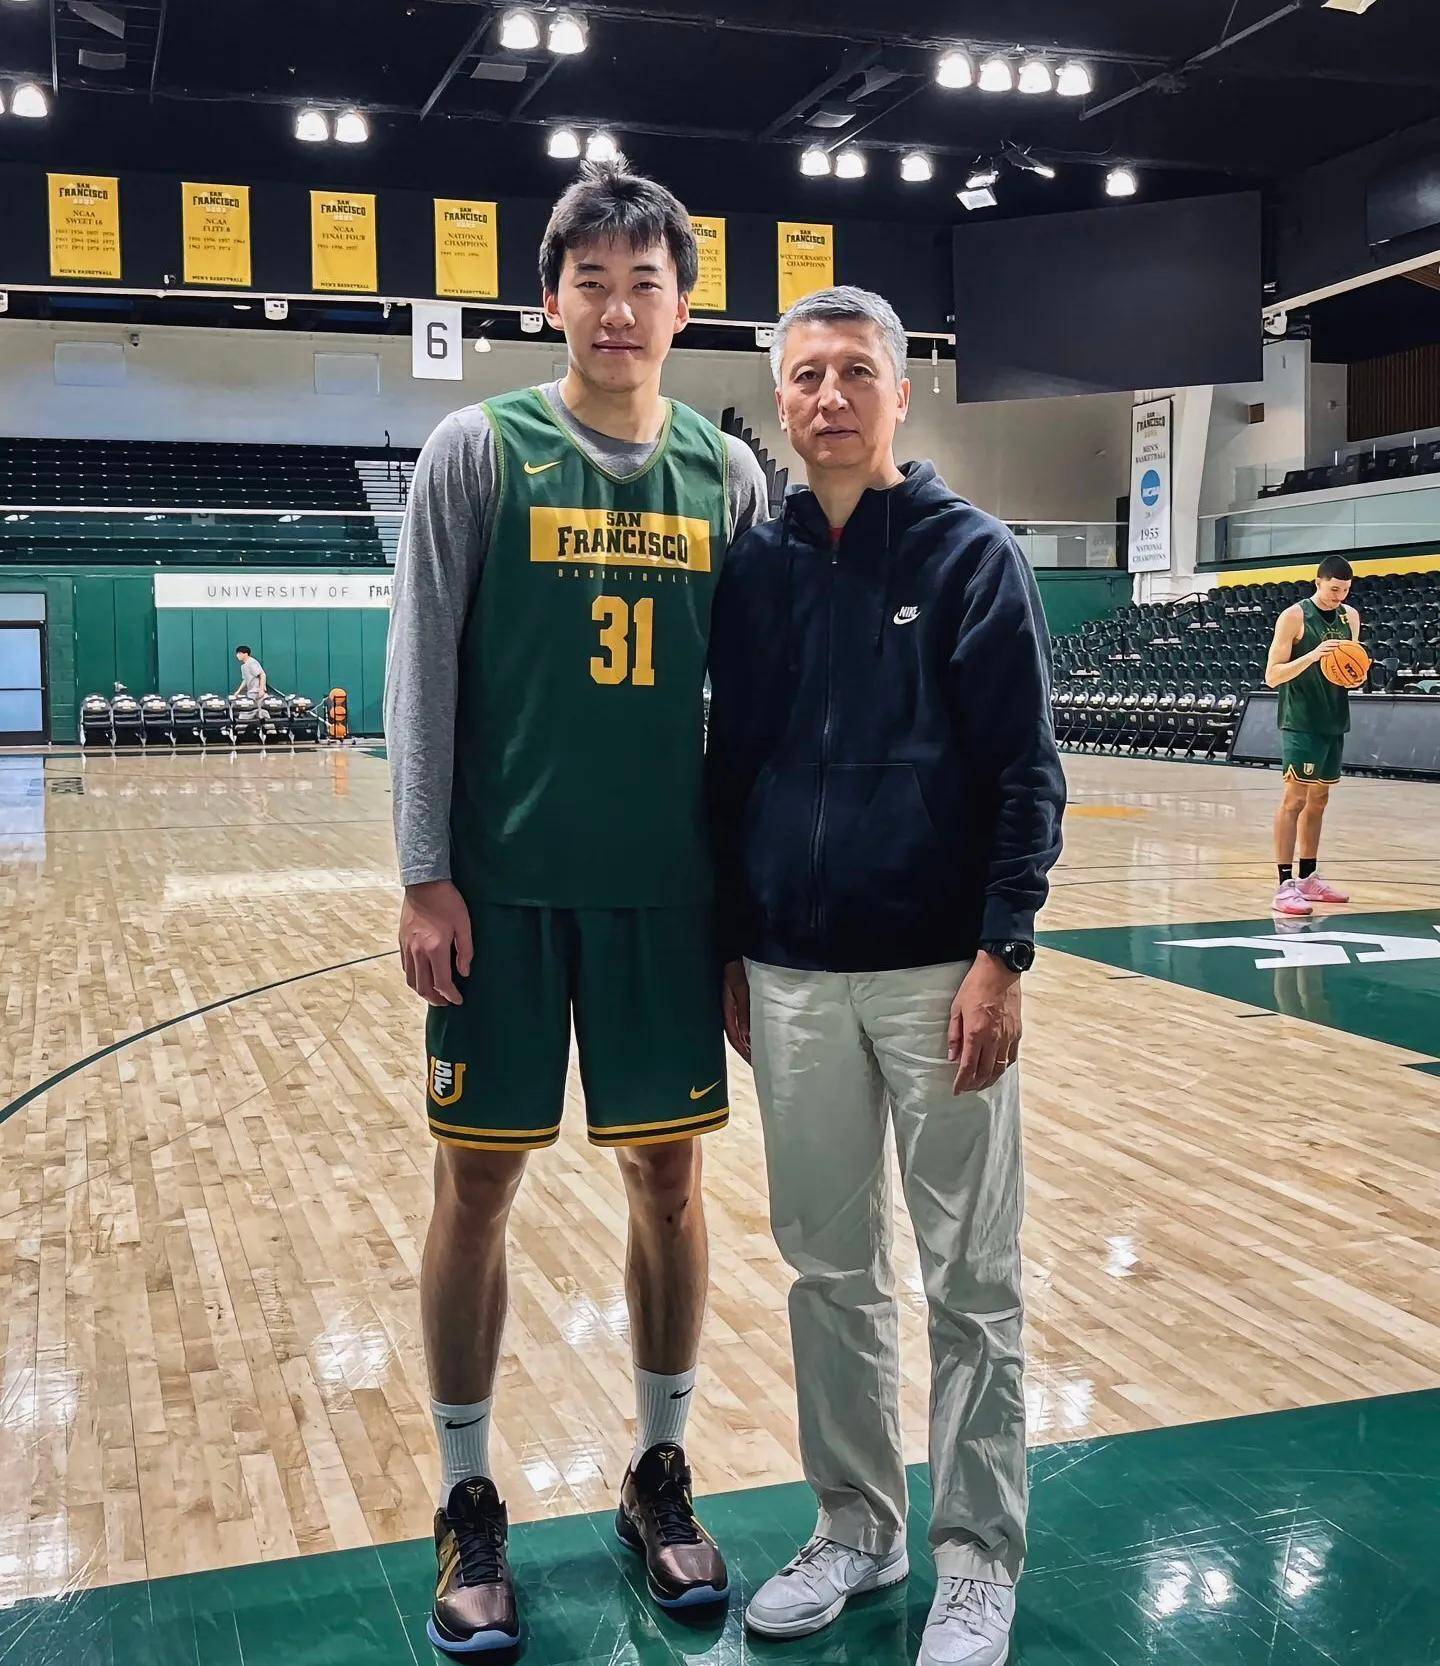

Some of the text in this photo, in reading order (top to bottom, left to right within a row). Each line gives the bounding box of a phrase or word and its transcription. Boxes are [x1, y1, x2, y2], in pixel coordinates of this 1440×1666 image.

[59, 187, 108, 200] FRANCISCO
[193, 196, 240, 208] FRANCISCO
[73, 210, 95, 218] NCAA
[321, 204, 366, 216] FRANCISCO
[444, 211, 488, 223] FRANCISCO
[333, 225, 355, 233] NCAA
[448, 232, 484, 240] NATIONAL
[786, 234, 826, 245] FRANCISCO
[444, 240, 489, 248] CHAMPIONS
[427, 322, 448, 359] 6
[1136, 415, 1166, 432] FRANCISCO
[606, 511, 642, 528] SAN
[1140, 528, 1159, 541] 1955
[557, 525, 688, 564] FRANCISCO
[1136, 542, 1163, 552] NATIONAL
[1132, 553, 1167, 564] CHAMPIONS
[558, 568, 689, 585] BASKETBALL
[207, 585, 318, 598] UNIVERSITY
[328, 586, 350, 598] OF
[898, 605, 918, 618] NIKE
[590, 595, 655, 686] 31
